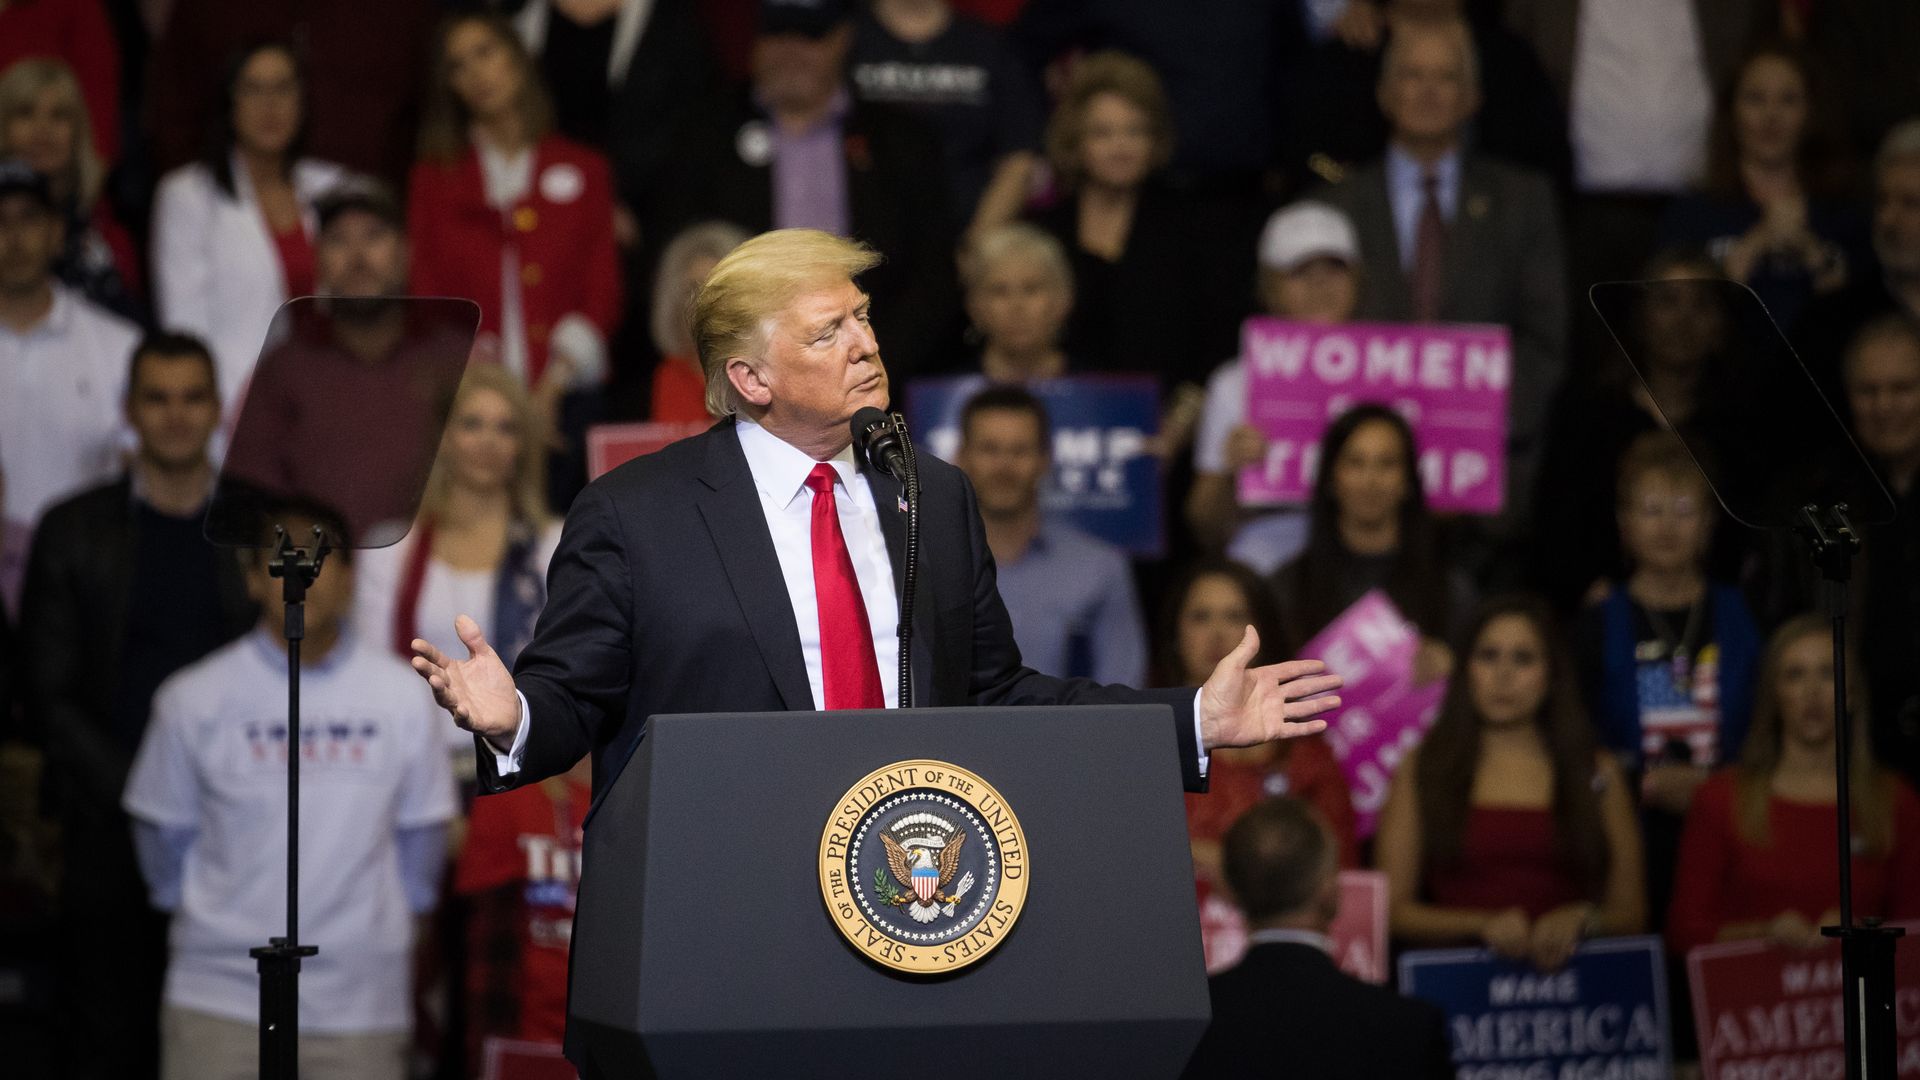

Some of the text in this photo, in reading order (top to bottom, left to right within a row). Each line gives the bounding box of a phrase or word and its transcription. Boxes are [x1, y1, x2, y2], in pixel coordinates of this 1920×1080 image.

[1249, 331, 1511, 391] WOMEN
[926, 427, 1144, 468] TMP
[827, 768, 1022, 963] SEAL OF THE PRESIDENT OF THE UNITED STATES
[1452, 1003, 1657, 1061] MERICA
